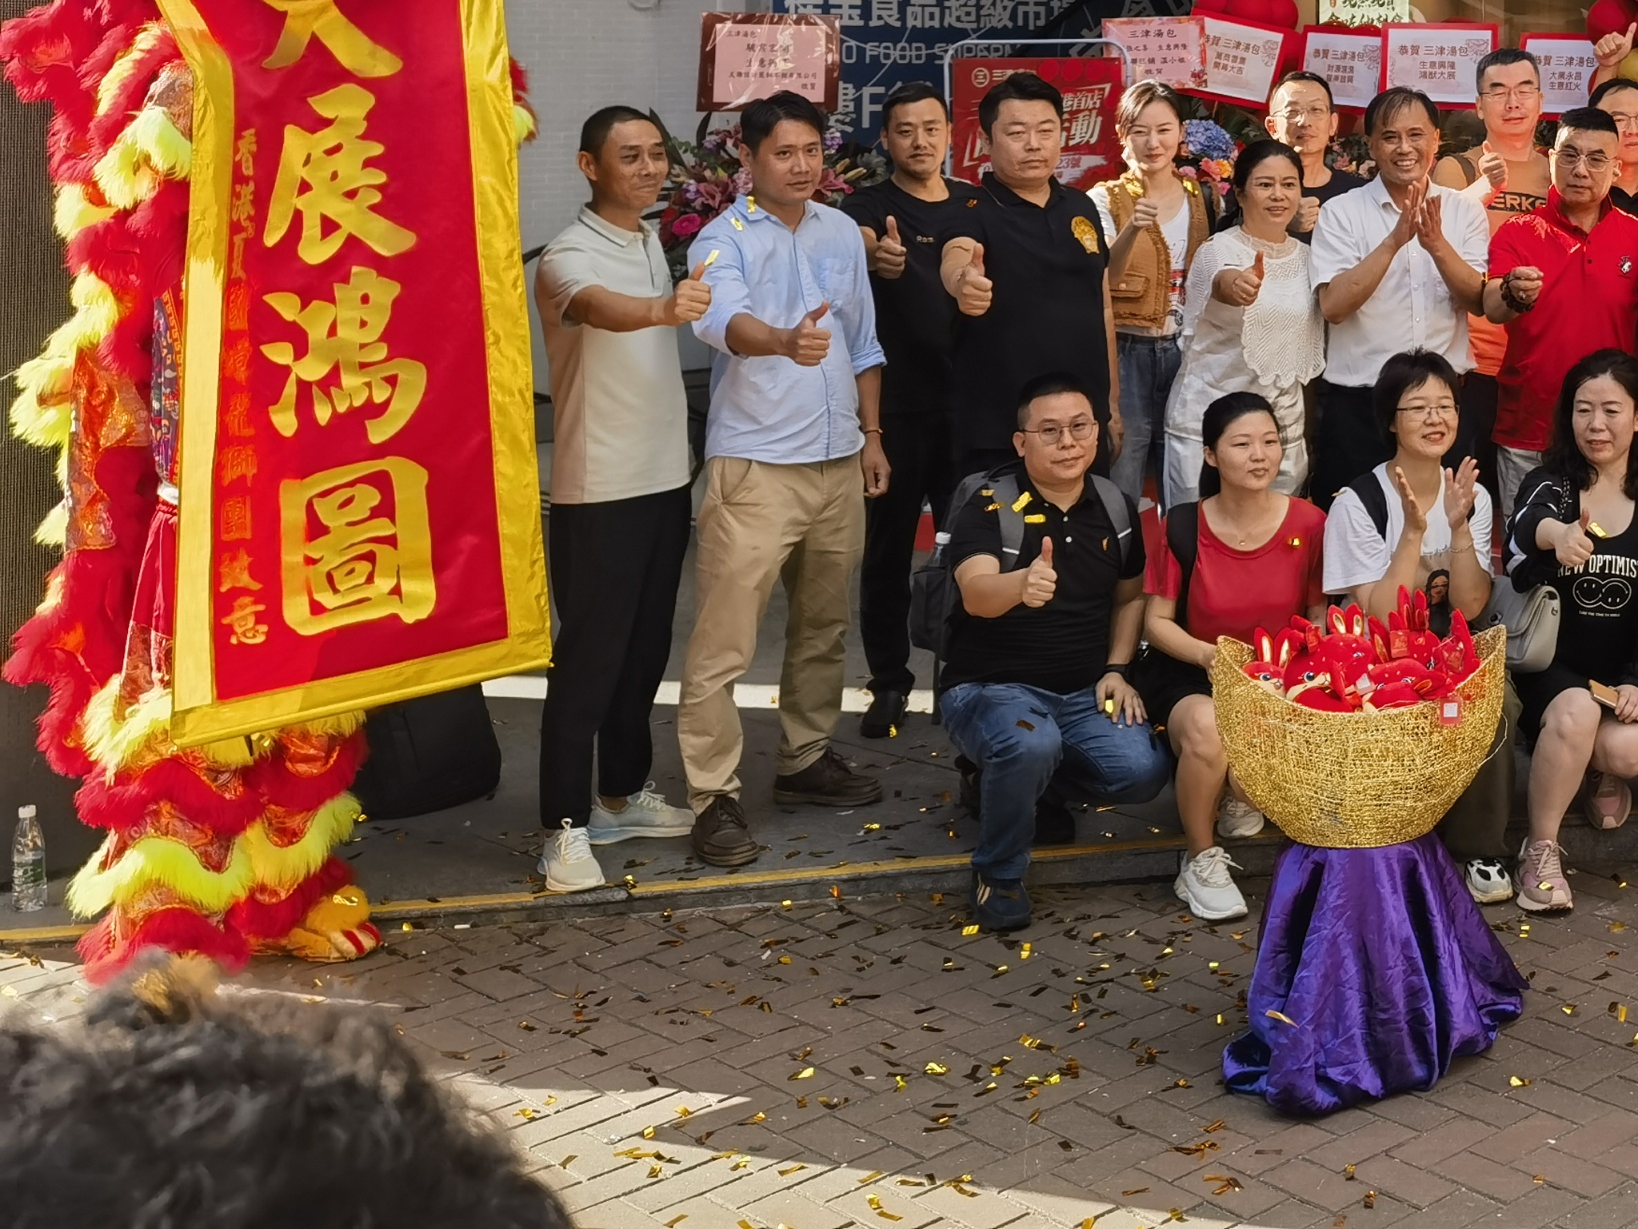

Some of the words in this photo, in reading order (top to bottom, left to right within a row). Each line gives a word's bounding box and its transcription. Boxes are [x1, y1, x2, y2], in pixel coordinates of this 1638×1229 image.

[1128, 28, 1177, 38] 三津湯包
[866, 42, 926, 64] FOOD
[1222, 38, 1261, 56] 三津湯包
[1398, 44, 1420, 56] 恭賀
[1423, 45, 1469, 57] 三津湯包
[1313, 48, 1330, 60] 恭賀
[1331, 50, 1365, 62] 三津湯包
[1419, 61, 1456, 70] 生意興隆
[1554, 56, 1595, 68] 三津湯包
[1548, 81, 1581, 91] 生意紅火
